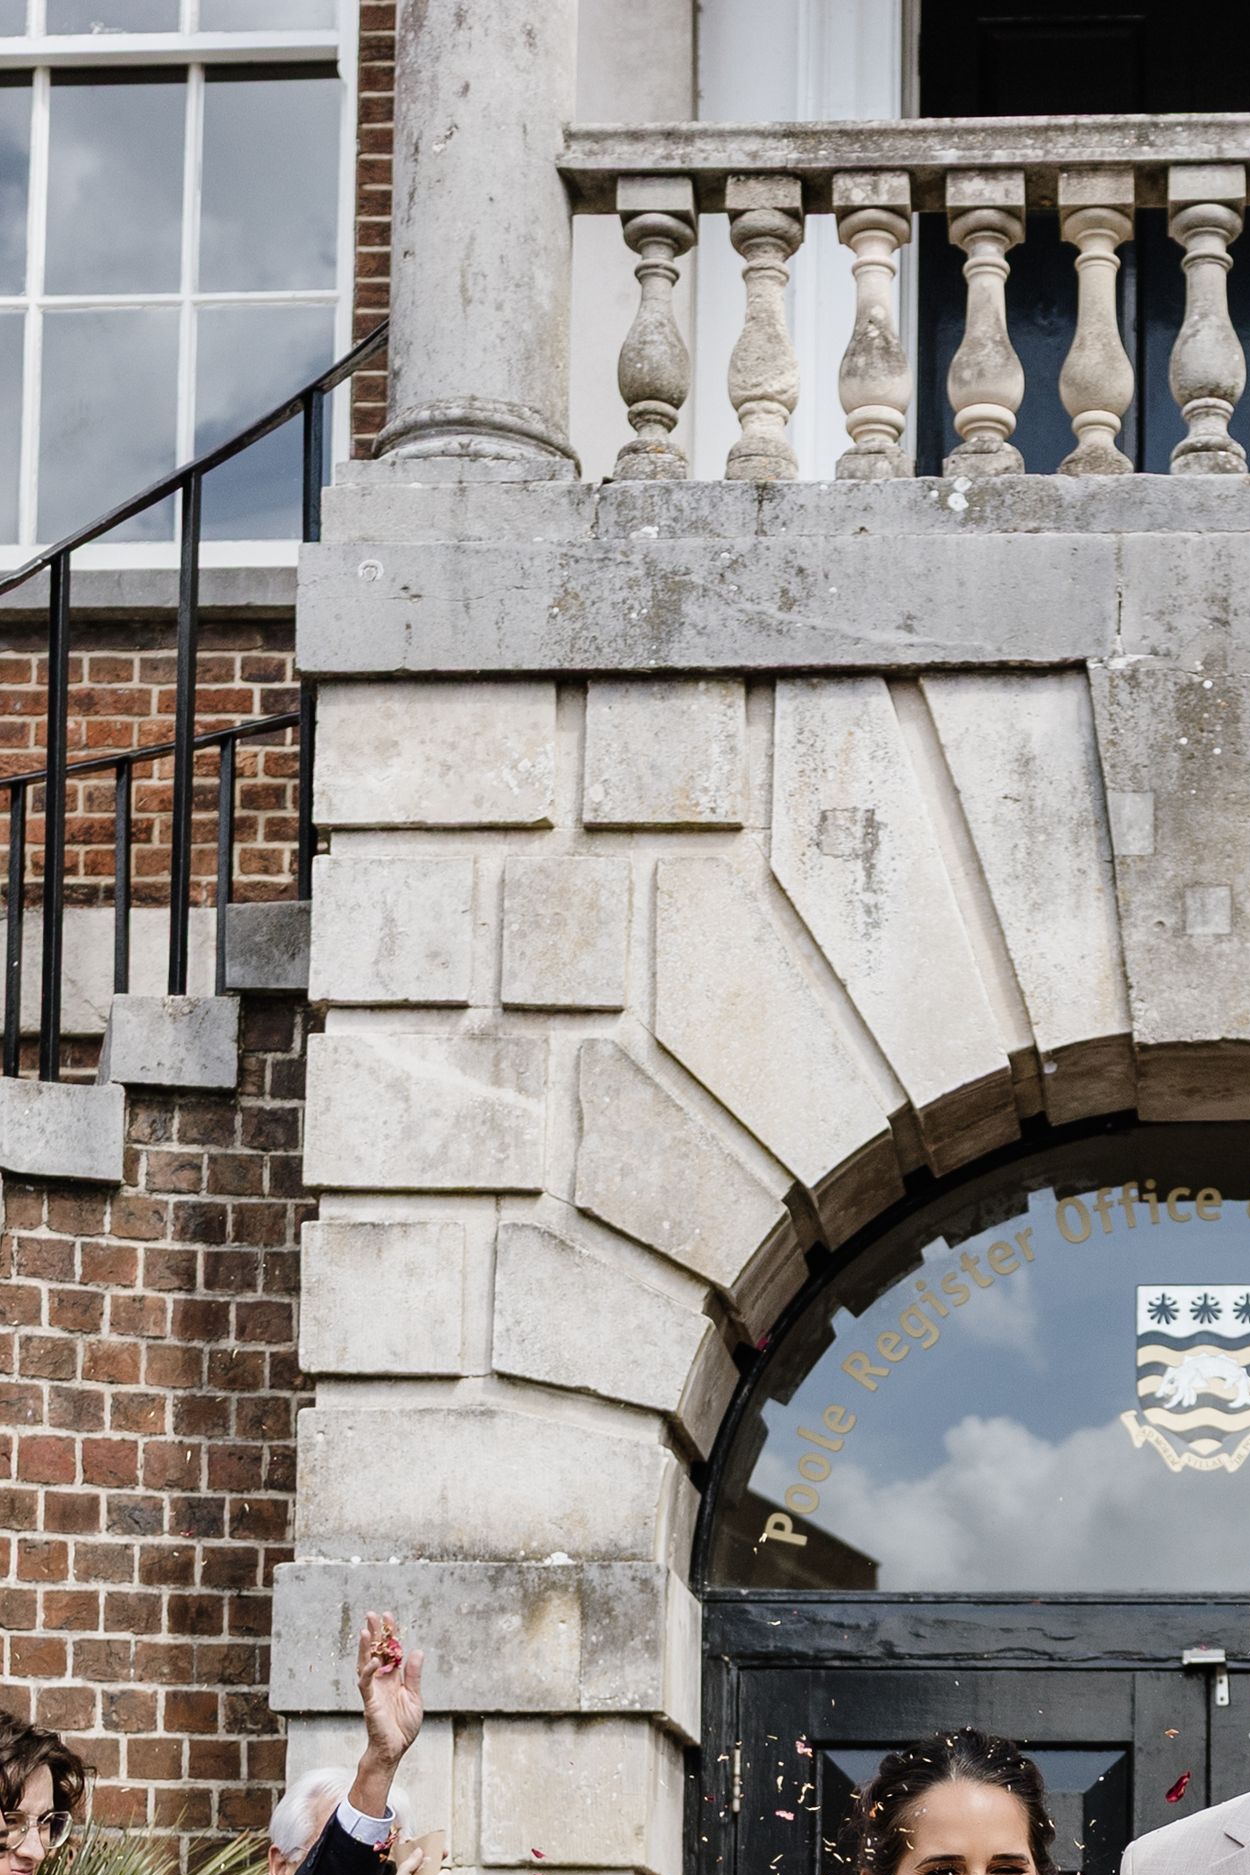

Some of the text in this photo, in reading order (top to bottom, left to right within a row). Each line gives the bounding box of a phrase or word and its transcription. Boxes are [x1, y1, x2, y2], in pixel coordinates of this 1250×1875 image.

[765, 1404, 857, 1546] Poole
[842, 1227, 1035, 1392] Register
[1055, 1178, 1223, 1244] Office
